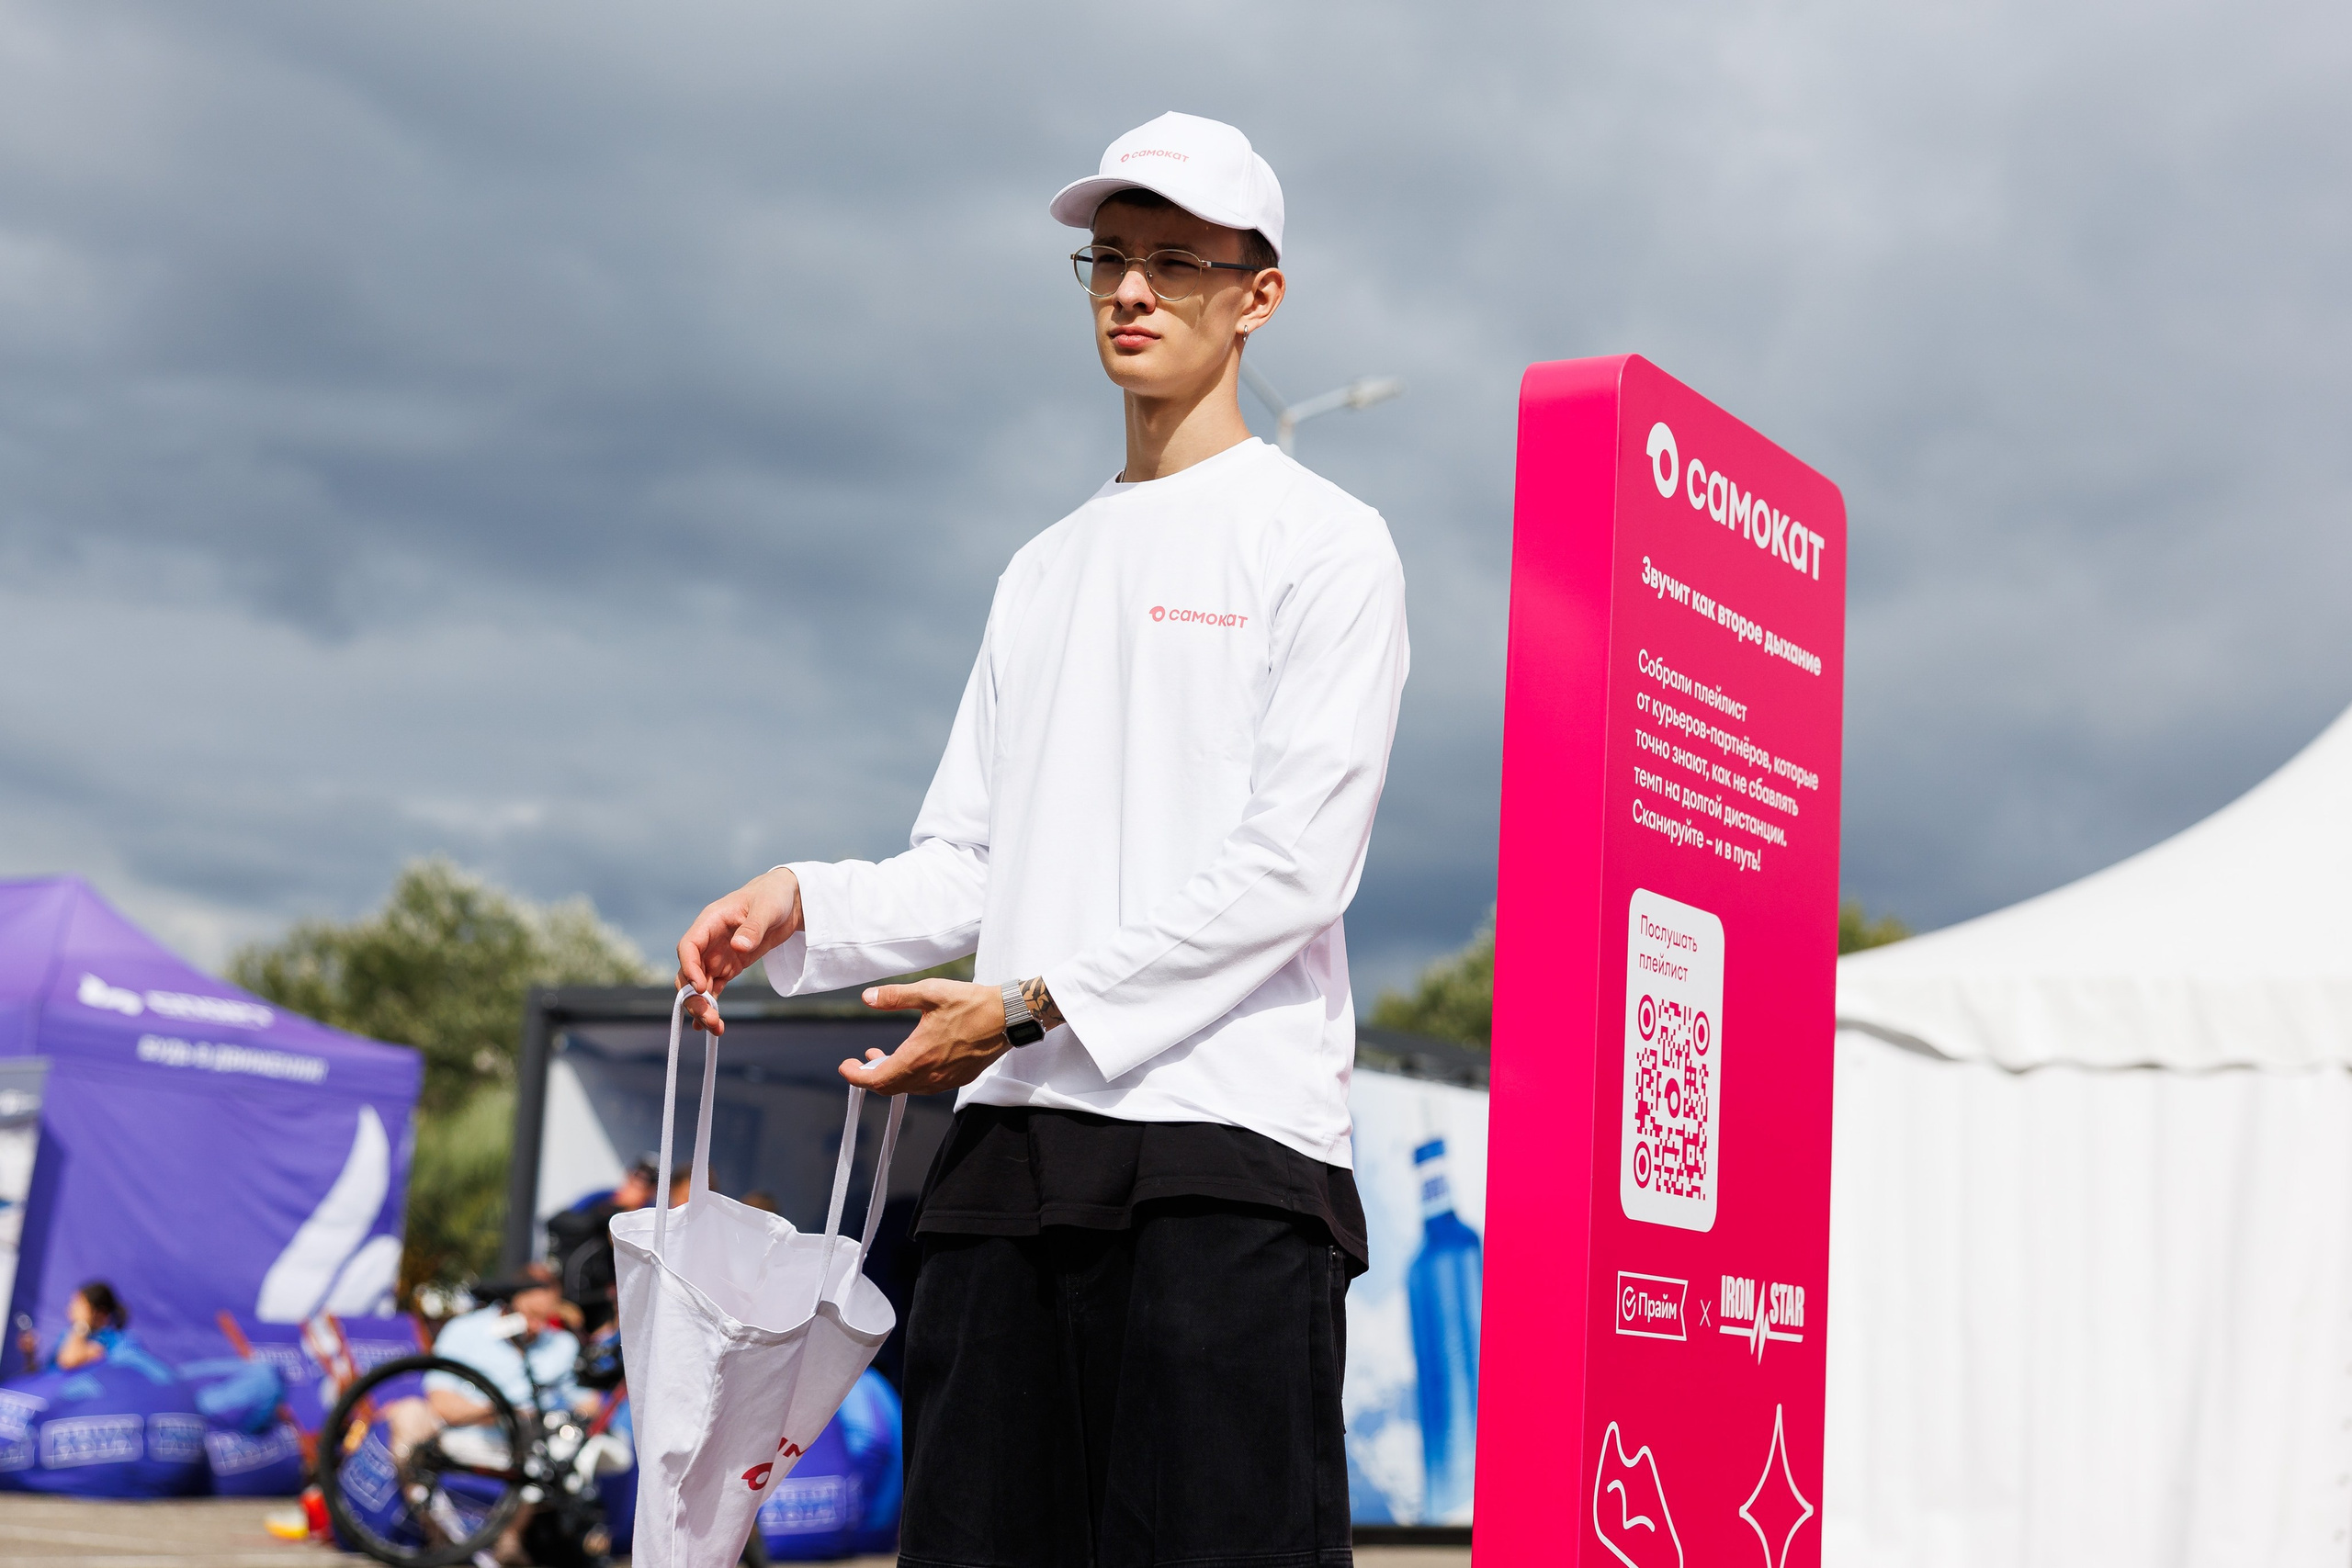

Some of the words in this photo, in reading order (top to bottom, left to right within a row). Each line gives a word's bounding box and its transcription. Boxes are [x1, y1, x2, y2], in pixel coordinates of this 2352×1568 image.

[1131, 150, 1190, 163] самокат
[1687, 458, 1825, 581] самокат
[1169, 609, 1249, 628] самокат
[1642, 557, 1690, 605] Звучит
[1692, 591, 1715, 620] как
[1718, 604, 1762, 645] второе
[1764, 631, 1821, 676] дыхание
[1639, 649, 1691, 695] Собрали
[1694, 682, 1747, 721] плейлист
[1635, 729, 1669, 759] точно
[1672, 746, 1709, 781] знают,
[1712, 764, 1731, 787] как
[1733, 773, 1747, 794] не
[1748, 778, 1798, 816] сбавлять
[1637, 693, 1650, 712] от
[1653, 699, 1771, 773] курьеров-партнёров,
[1774, 757, 1818, 790] которые
[1633, 799, 1703, 848] Сканируйте
[1715, 839, 1723, 856] и
[1724, 842, 1731, 859] в
[1734, 846, 1760, 871] путь!
[1634, 767, 1662, 794] темп
[1666, 780, 1679, 801] на
[1682, 788, 1722, 819] долгой
[1724, 806, 1787, 846] дистанции.
[1639, 953, 1689, 982] плейлист
[1641, 915, 1697, 952] Послушать
[1639, 1292, 1677, 1323] Прайм
[1720, 1275, 1755, 1320] IRON
[1770, 1281, 1805, 1326] STAR
